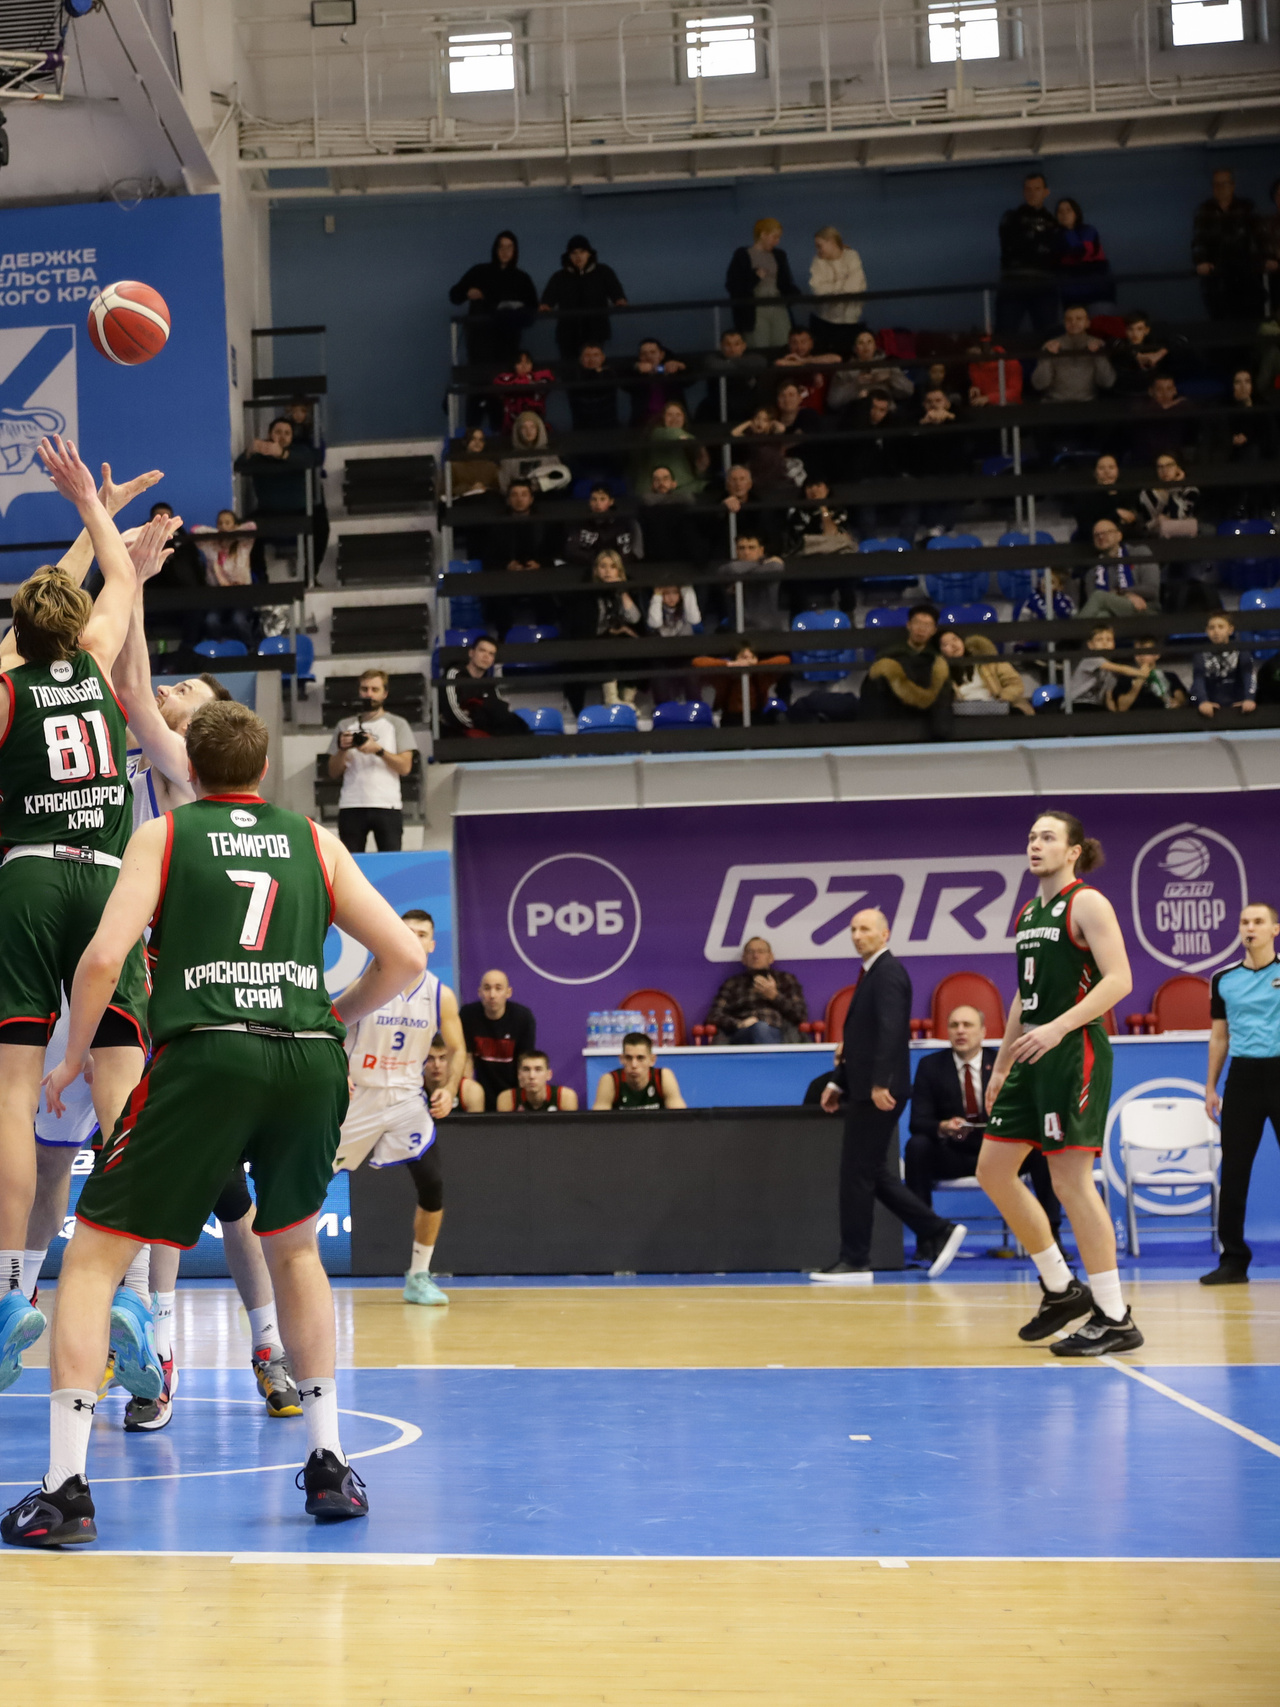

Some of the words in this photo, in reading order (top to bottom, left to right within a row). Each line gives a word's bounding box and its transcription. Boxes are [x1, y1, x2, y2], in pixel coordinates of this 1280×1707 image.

[57, 285, 102, 303] КРА
[53, 666, 70, 675] РФБ
[42, 709, 116, 783] 81
[67, 807, 105, 830] КРАЙ
[207, 832, 291, 859] ТЕМИРОВ
[225, 869, 276, 948] 7
[526, 900, 625, 937] РФБ
[721, 867, 1040, 947] PARI
[1155, 898, 1227, 932] СУПЕР
[1171, 931, 1212, 956] ЛИГА
[1024, 956, 1035, 985] 4
[234, 985, 283, 1009] КРАЙ
[391, 1031, 405, 1051] 3
[1044, 1112, 1062, 1141] 4
[409, 1133, 423, 1150] 3
